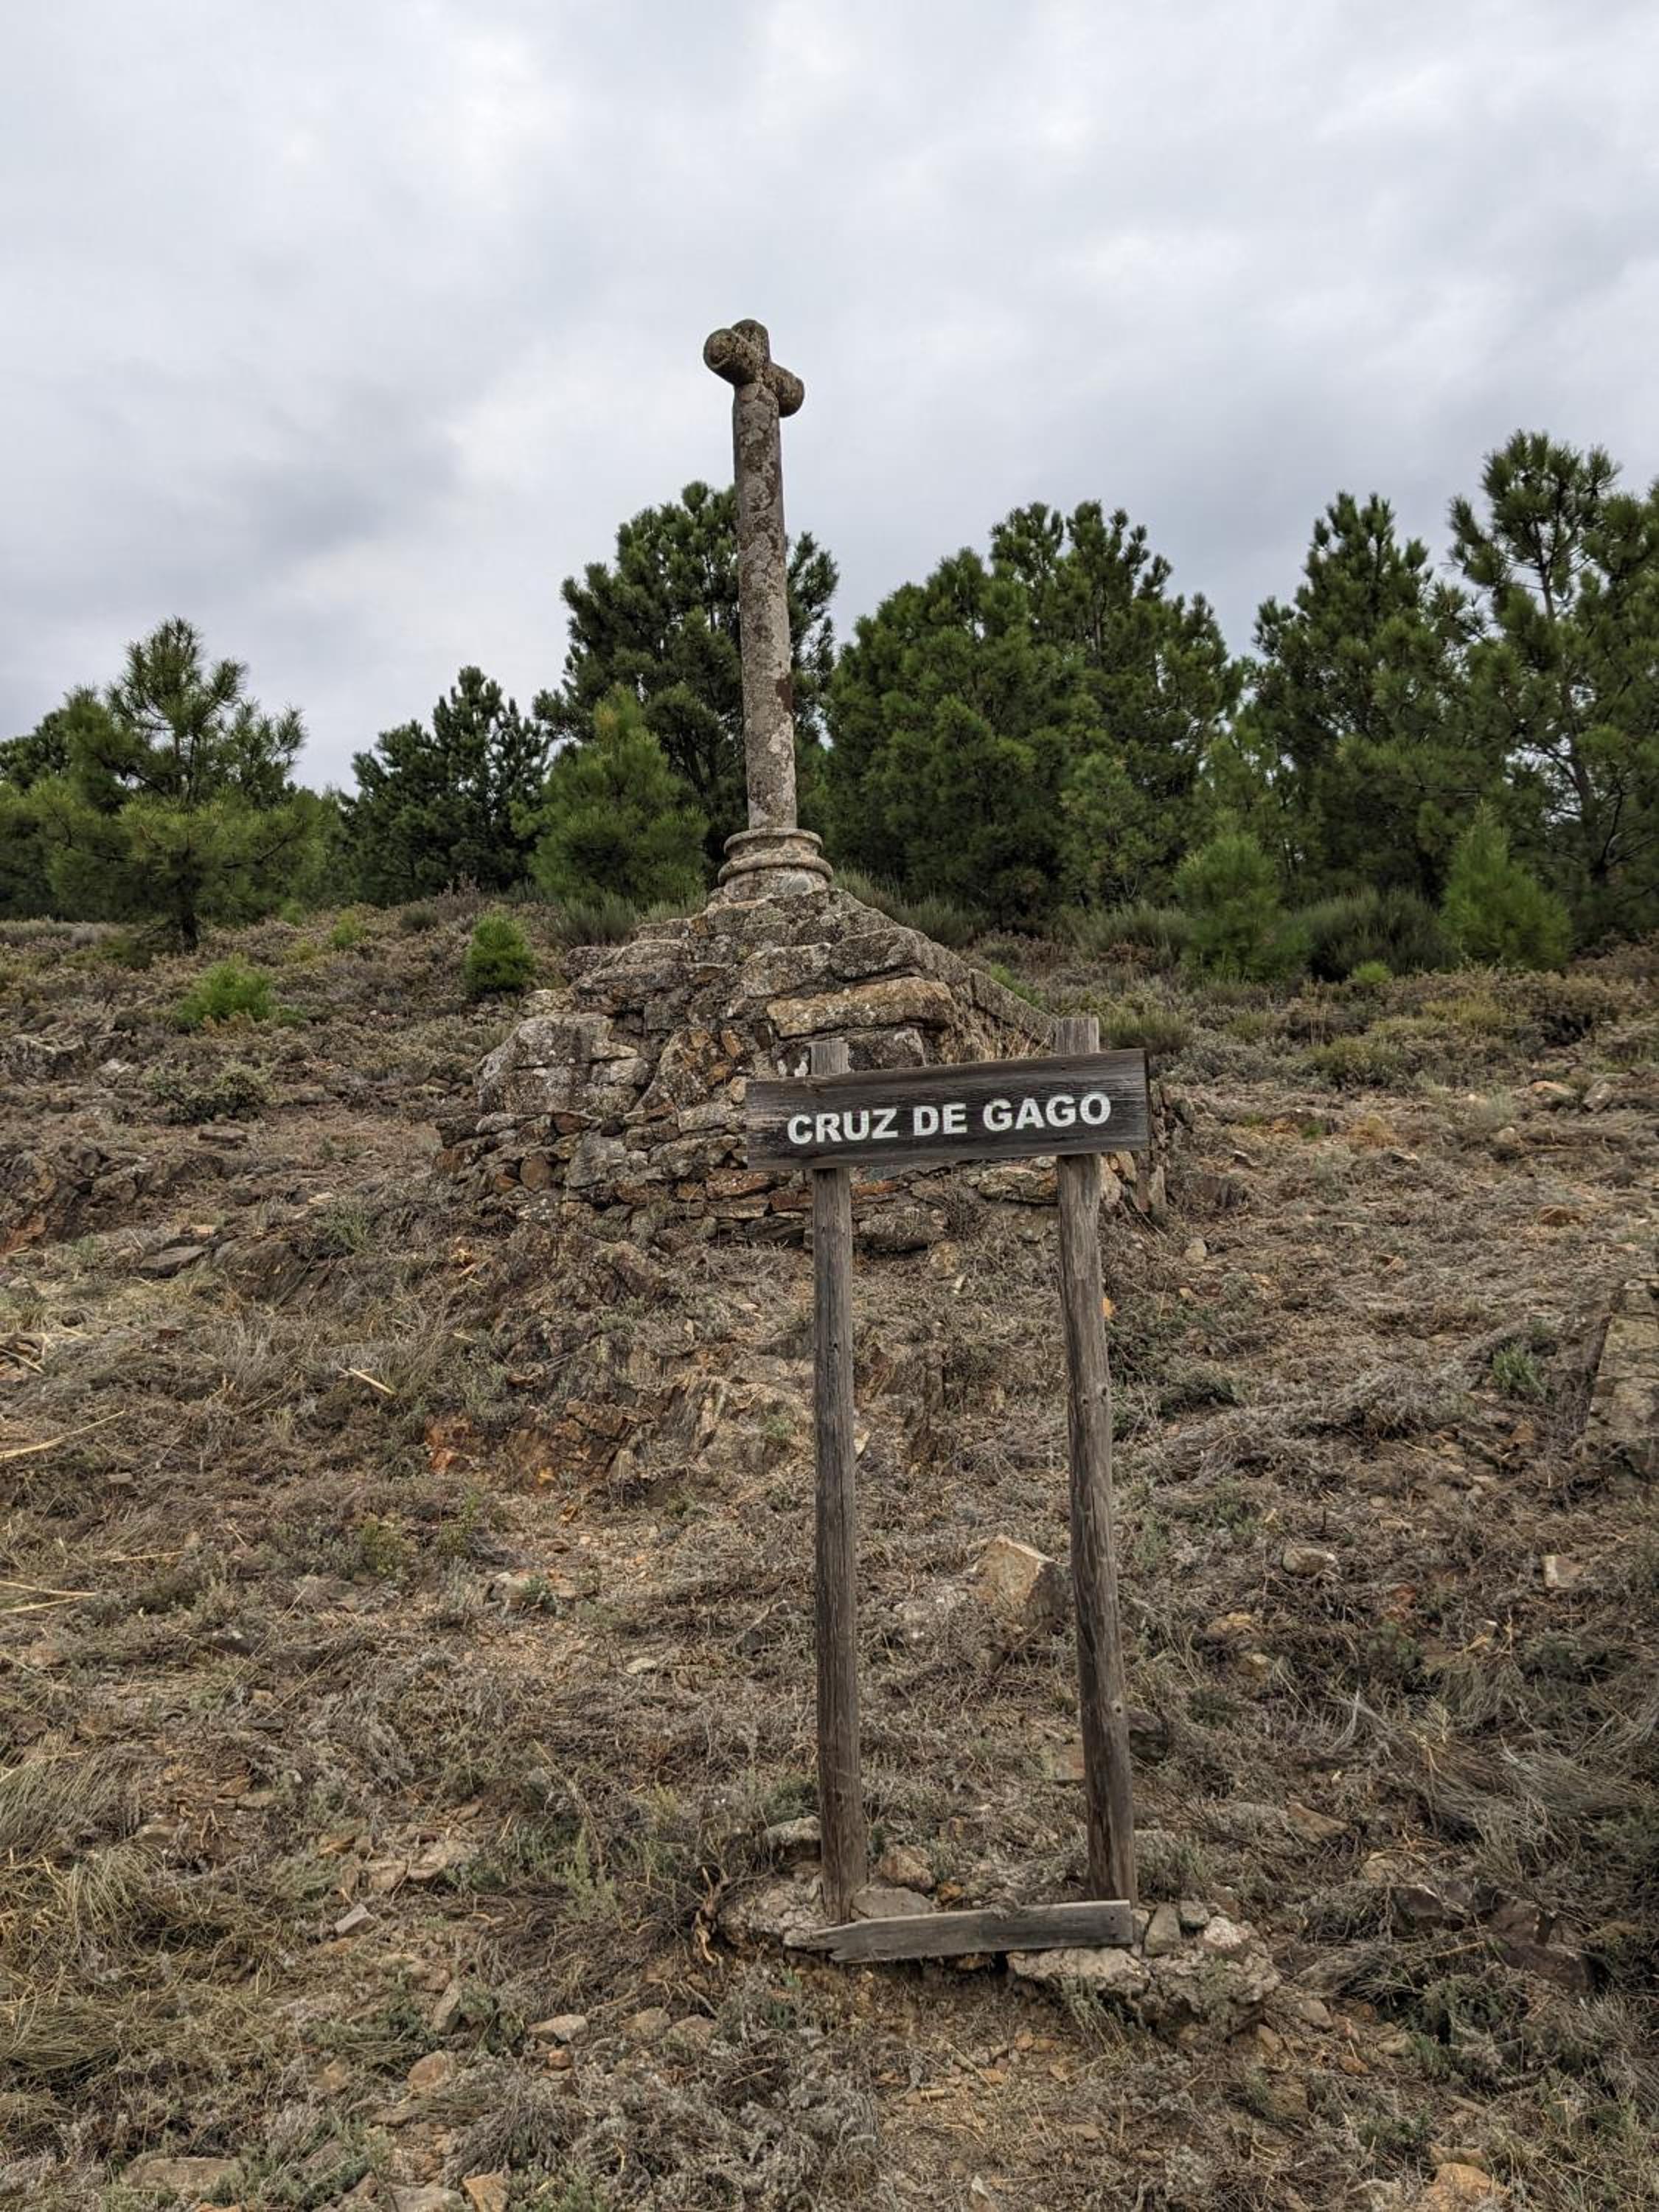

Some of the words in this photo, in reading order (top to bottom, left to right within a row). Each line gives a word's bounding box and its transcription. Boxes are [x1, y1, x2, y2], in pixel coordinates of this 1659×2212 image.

[787, 1108, 898, 1144] CRUZ
[913, 1104, 967, 1135] DE
[983, 1093, 1111, 1131] GAGO
